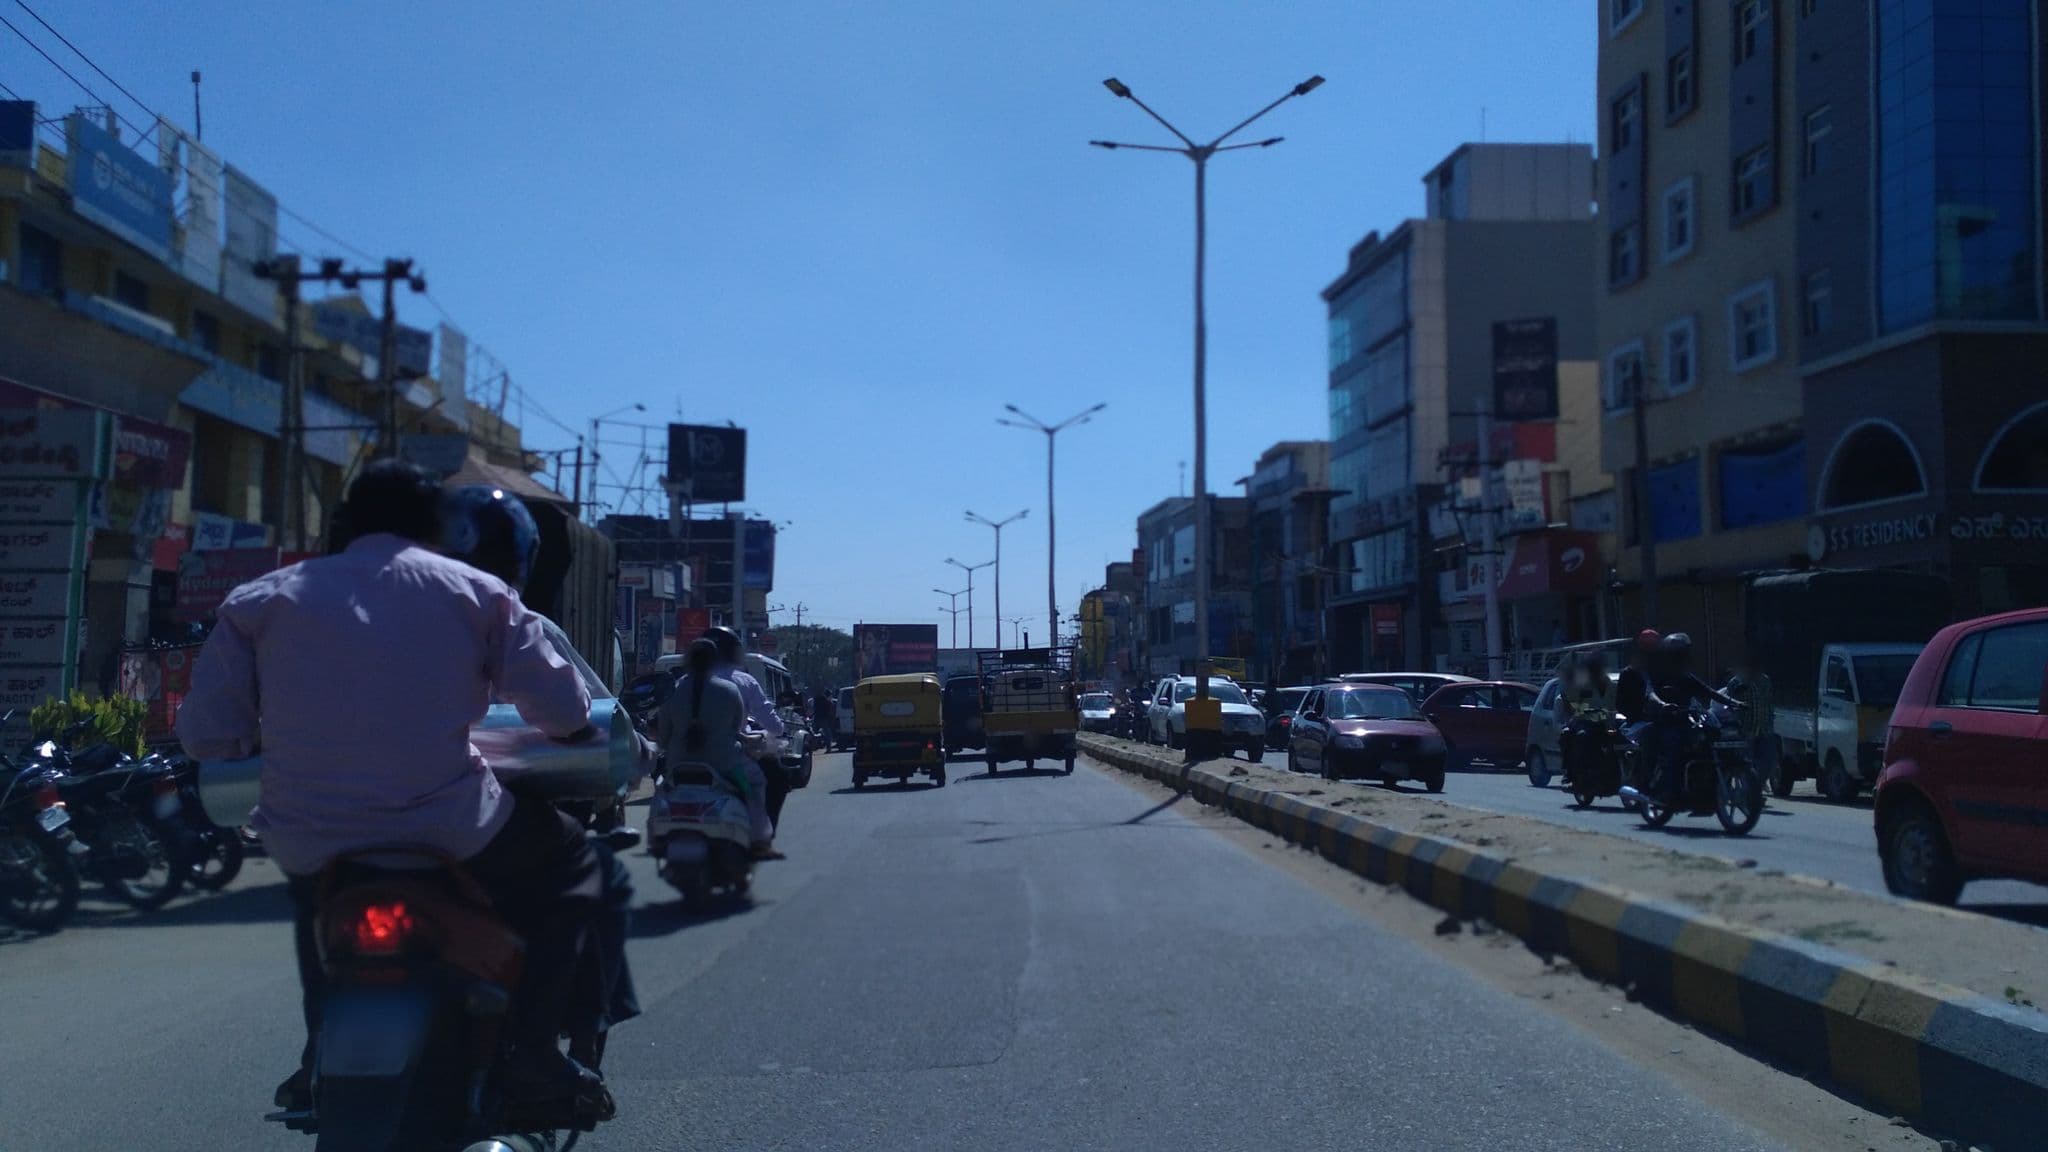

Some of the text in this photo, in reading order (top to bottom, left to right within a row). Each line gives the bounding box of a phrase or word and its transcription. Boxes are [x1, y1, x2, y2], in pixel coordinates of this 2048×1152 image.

[1830, 512, 1937, 552] S S RESIDENCY
